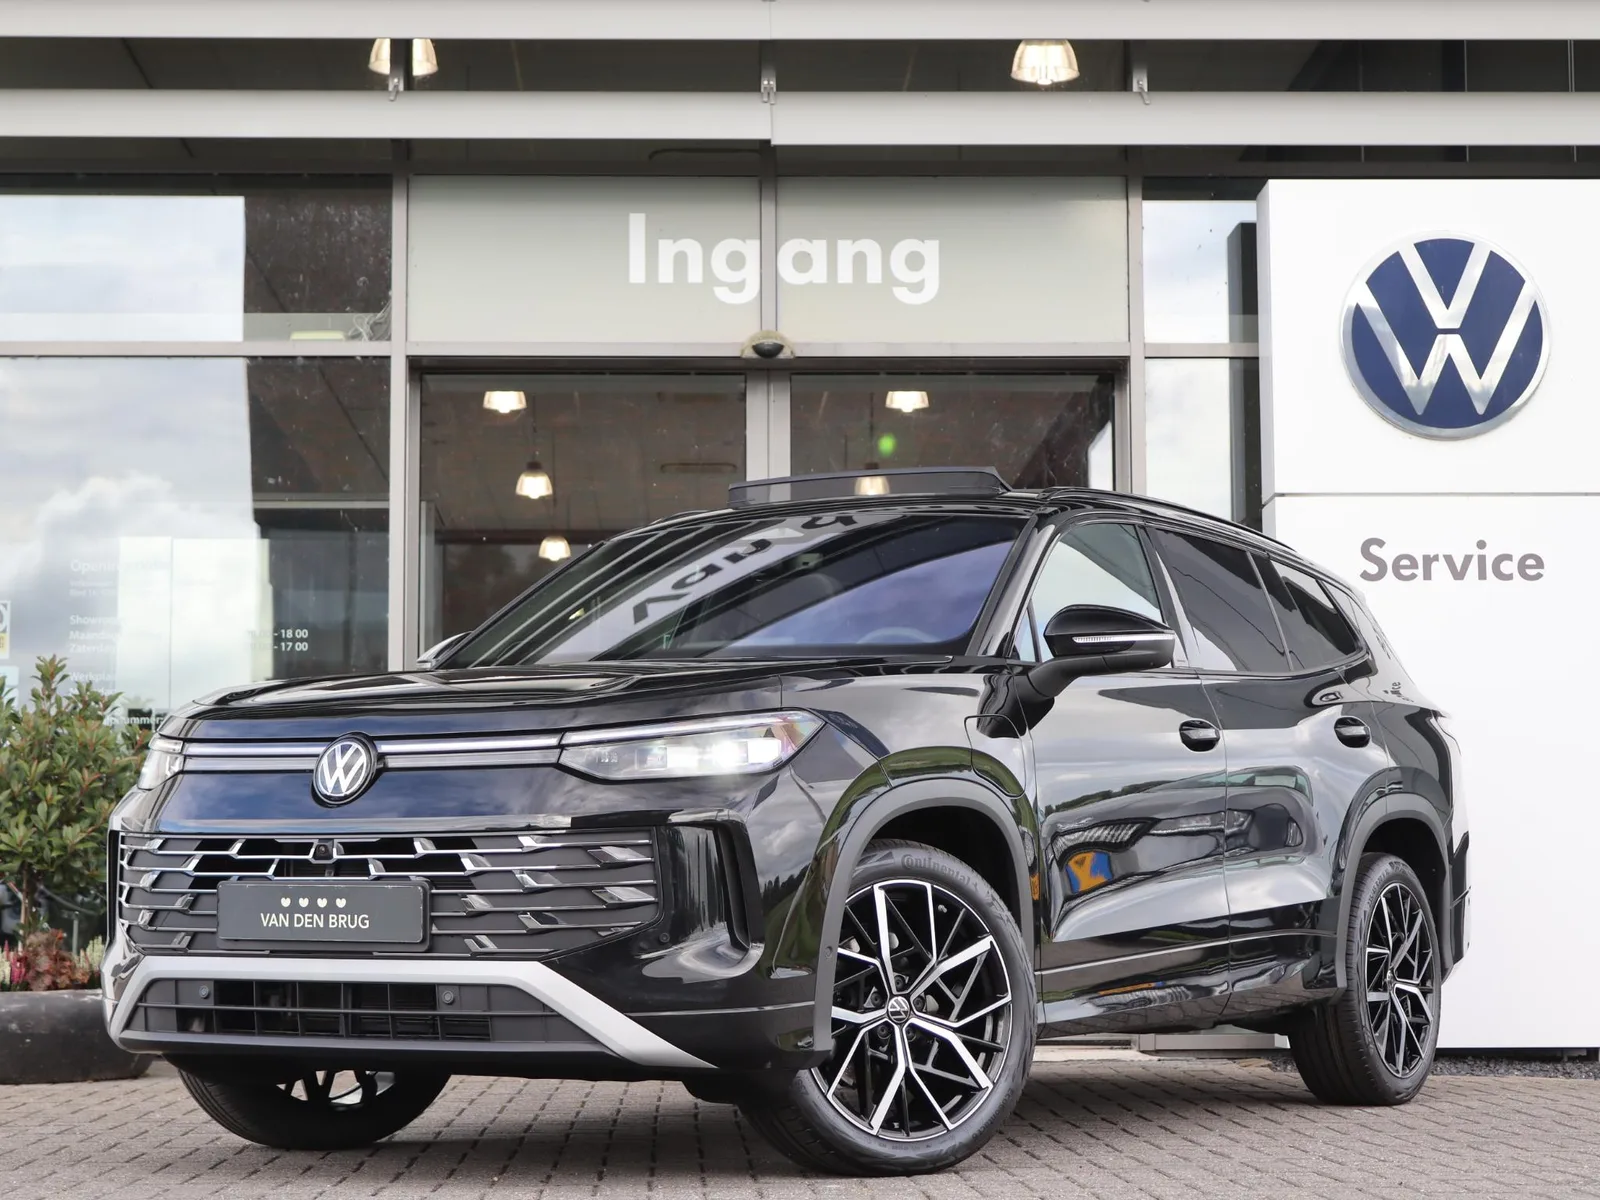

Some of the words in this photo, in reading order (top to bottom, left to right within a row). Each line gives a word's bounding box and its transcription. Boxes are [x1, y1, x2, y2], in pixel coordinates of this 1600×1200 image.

[629, 213, 940, 304] Ingang
[1359, 537, 1545, 582] Service
[901, 854, 971, 886] Continental
[260, 912, 290, 928] VAN
[293, 913, 325, 928] DEN
[328, 914, 370, 929] BRUG
